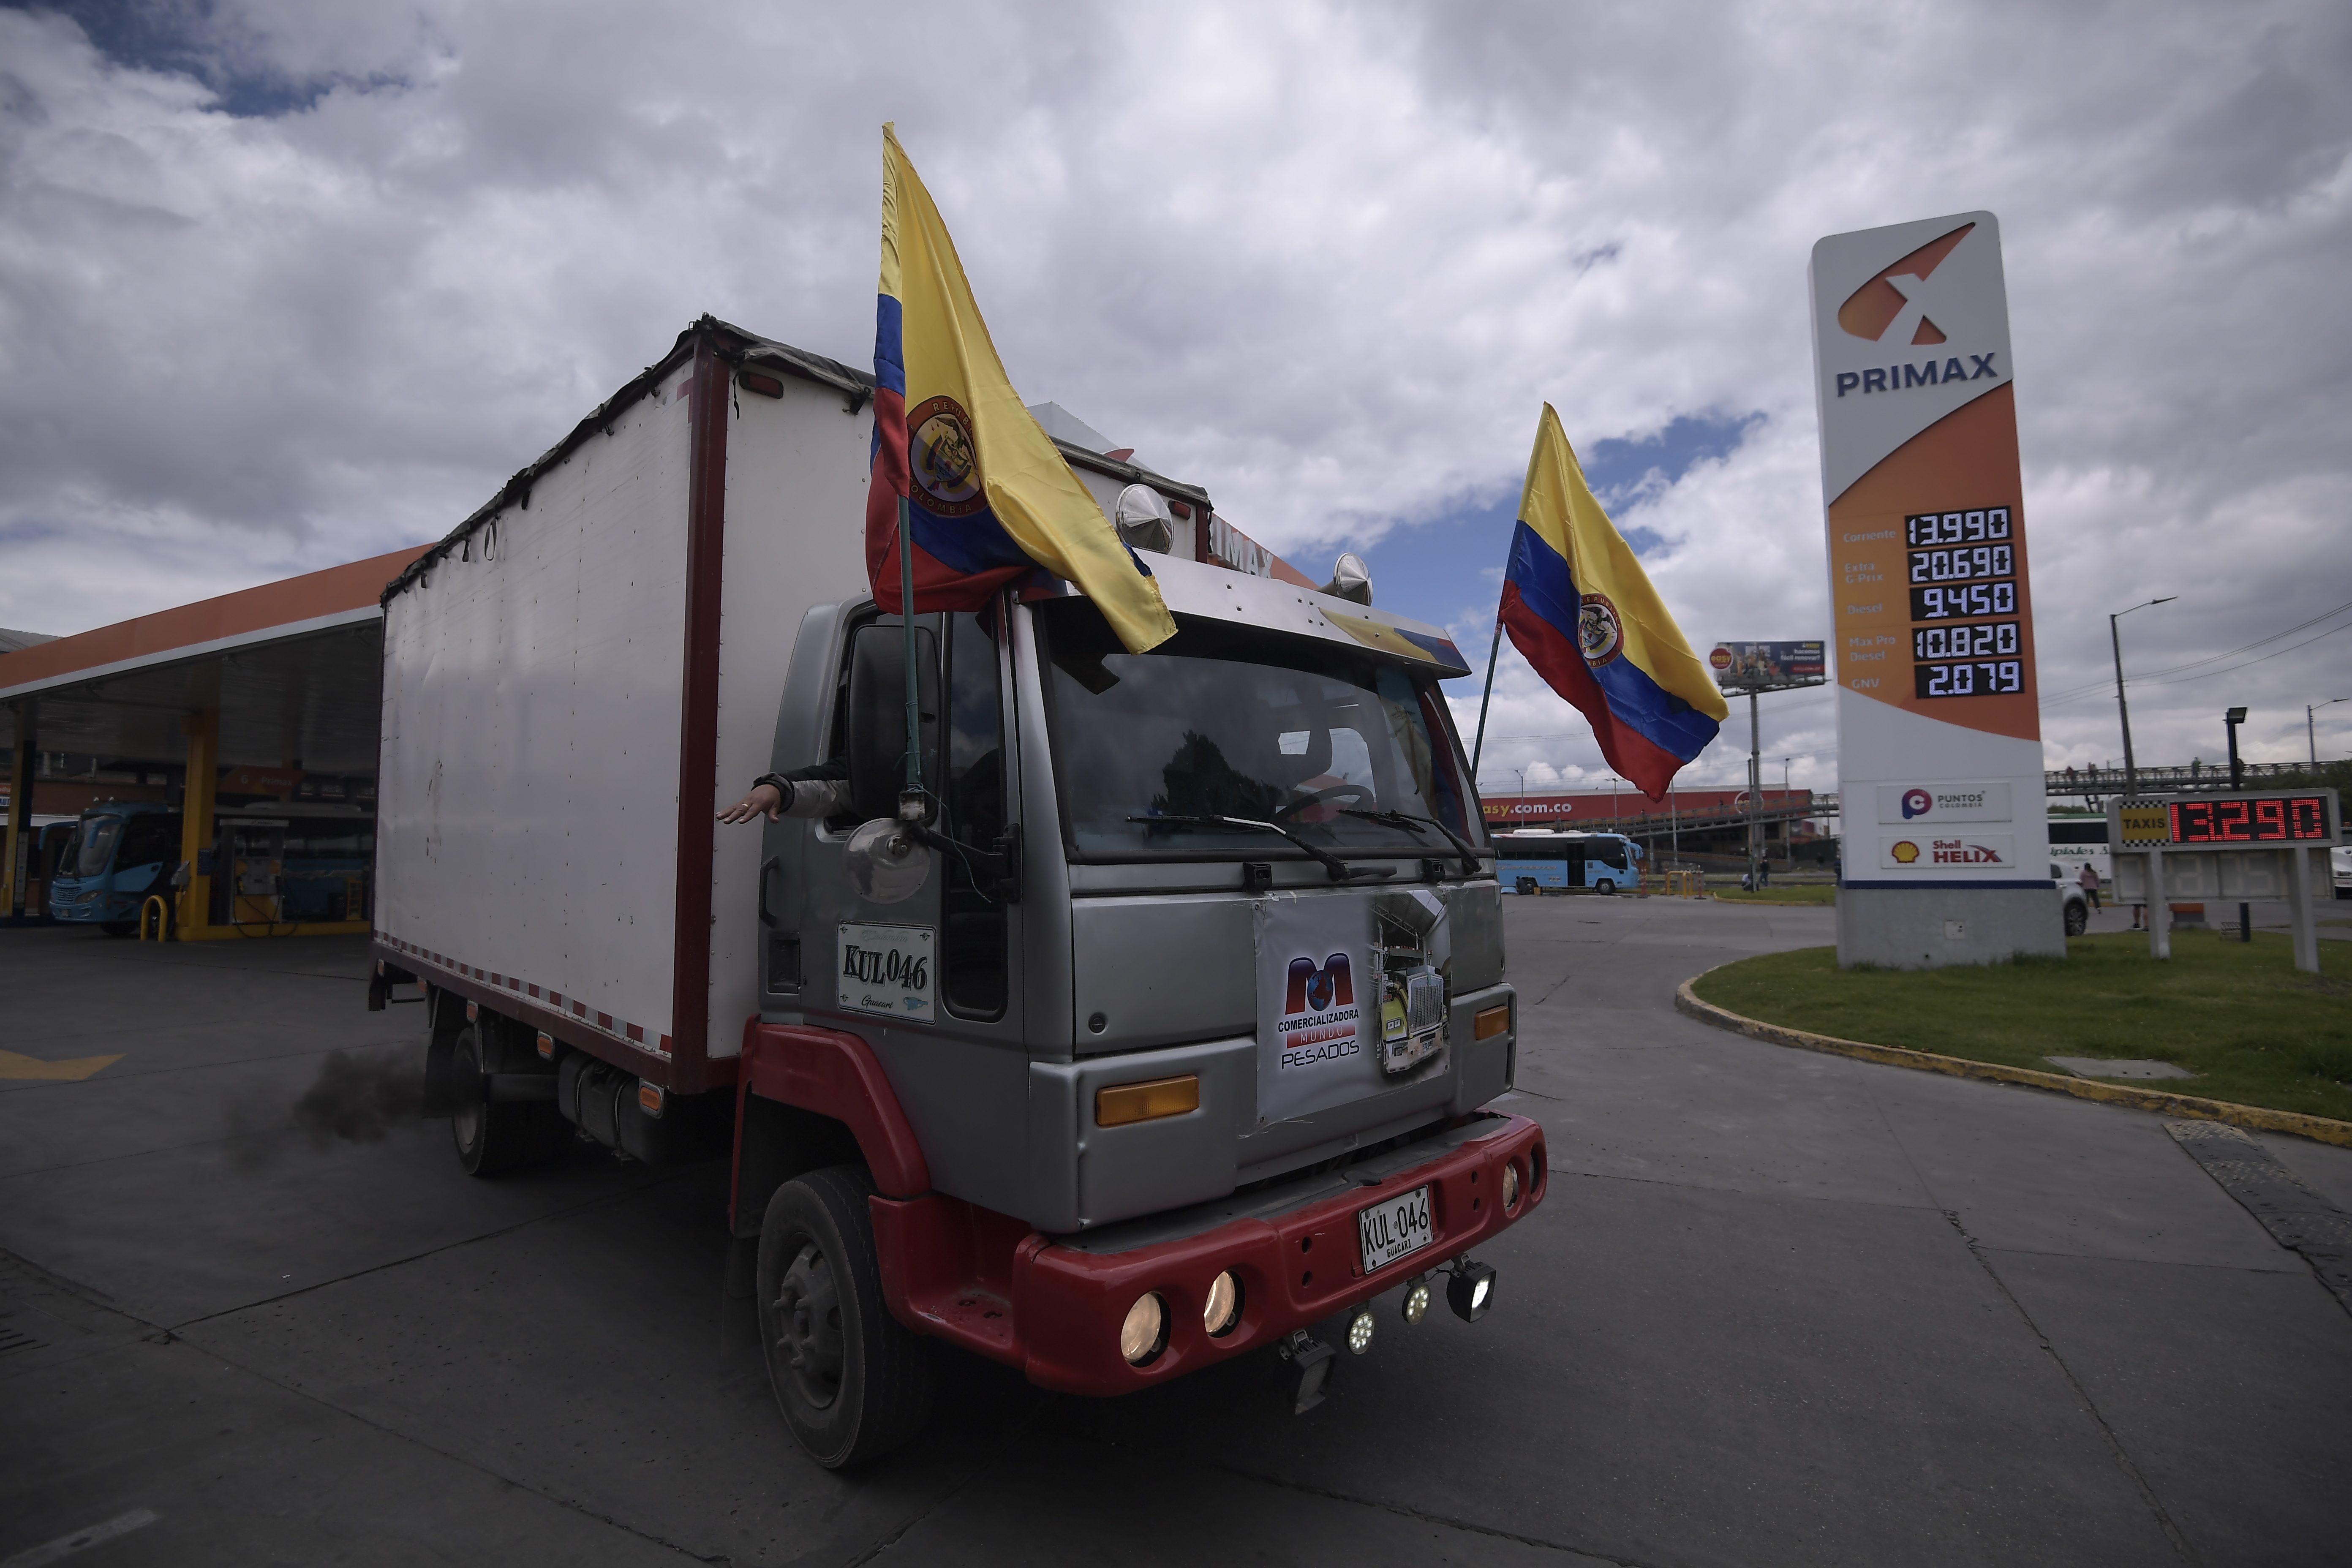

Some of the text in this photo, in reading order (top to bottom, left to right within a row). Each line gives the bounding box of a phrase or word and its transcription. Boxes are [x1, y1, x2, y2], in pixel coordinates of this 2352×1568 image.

[1837, 352, 1998, 397] PRIMAX
[1908, 508, 2008, 545] 13.990
[1844, 529, 1896, 542] Corriente
[1210, 516, 1274, 579] IMAX
[1845, 563, 1875, 572] Extra
[1912, 545, 2011, 582] 20.690
[1846, 573, 1884, 583] G-Prix
[1924, 583, 2014, 617] 9.450
[1848, 604, 1882, 615] Diesel
[1850, 636, 1896, 646] Max Pro
[1916, 624, 2017, 659] 10.820
[1851, 651, 1885, 661] Diesel
[1852, 678, 1879, 689] GNV
[1929, 662, 2020, 696] 2.079
[240, 774, 292, 786] 6 Primax
[1938, 794, 1982, 802] PUNTOS
[2123, 818, 2165, 829] TAXIS
[1933, 840, 1961, 849] Shell
[1933, 849, 2003, 863] HELIX
[1278, 1009, 1359, 1033] COMERCIALIZADORA
[1301, 1026, 1344, 1044] MUNDO
[1282, 1040, 1359, 1069] PESADOS
[1387, 1238, 1412, 1258] GUACARI
